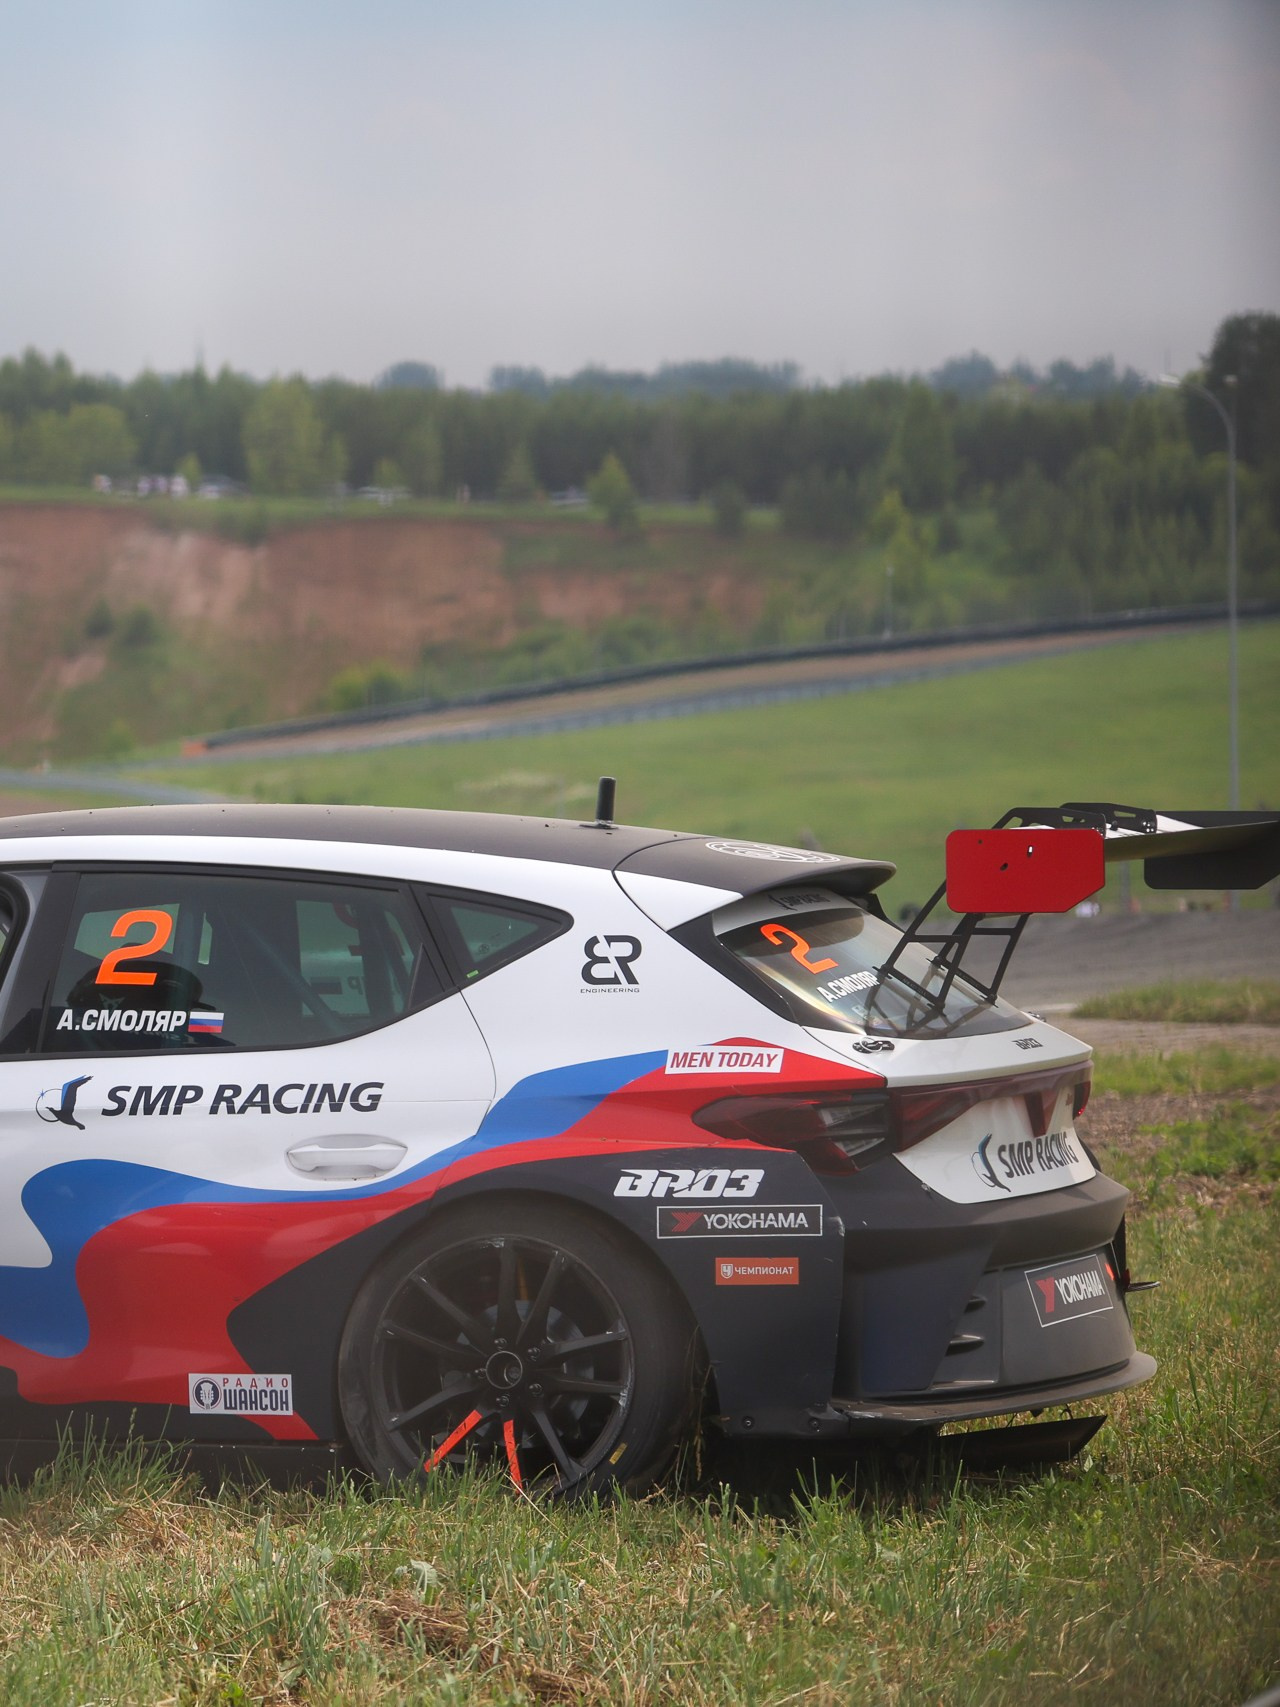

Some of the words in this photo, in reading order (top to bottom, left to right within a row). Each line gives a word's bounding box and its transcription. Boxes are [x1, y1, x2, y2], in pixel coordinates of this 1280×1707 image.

[95, 909, 173, 985] 2
[760, 923, 839, 975] 2
[56, 1009, 187, 1032] А.СМОЛЯР
[670, 1052, 714, 1068] MEN
[718, 1052, 778, 1068] TODAY
[101, 1085, 203, 1116] SMP
[208, 1082, 384, 1115] RACING
[998, 1141, 1035, 1178] SMP
[1035, 1131, 1079, 1172] RACING
[704, 1212, 809, 1229] YOKOHAMA
[734, 1266, 794, 1275] ЧЕМПИОНАТ
[1054, 1270, 1106, 1305] YOKOHAMA
[223, 1377, 288, 1389] РАДИО
[223, 1388, 289, 1412] ШАНСОН
